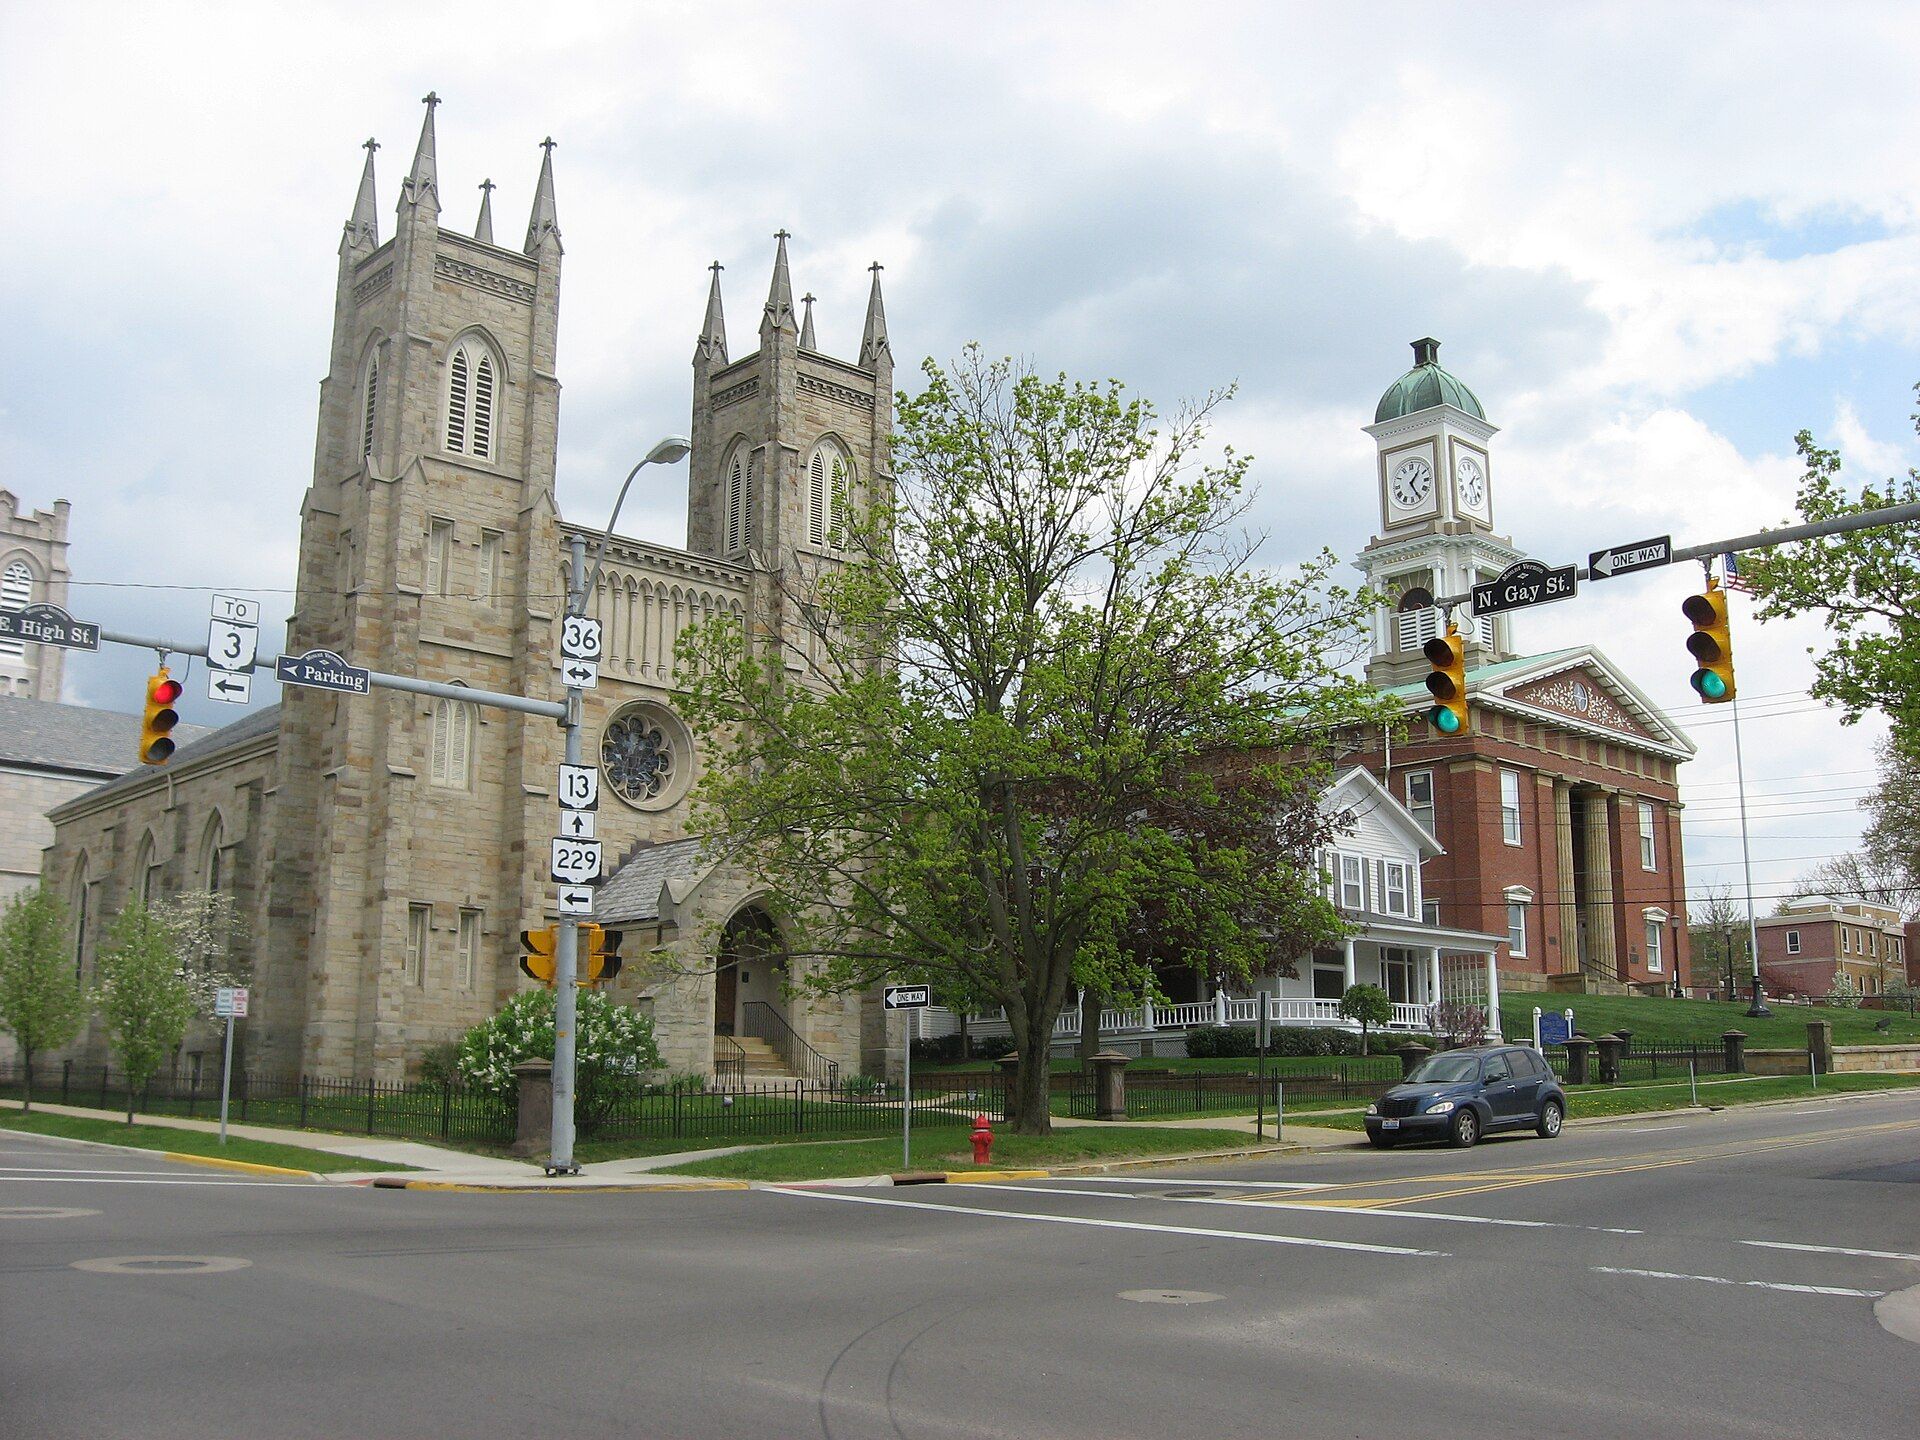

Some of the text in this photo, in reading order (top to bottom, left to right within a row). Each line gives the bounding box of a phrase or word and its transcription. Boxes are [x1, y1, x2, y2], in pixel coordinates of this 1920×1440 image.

[1612, 546, 1662, 567] ONE WAY
[1501, 563, 1544, 581] Mount Vernon
[1478, 576, 1570, 608] N. Gay St.
[224, 601, 247, 617] TO
[0, 616, 94, 644] E. High St.
[566, 624, 597, 650] 36
[223, 632, 242, 659] 3
[304, 665, 365, 690] Parking
[568, 773, 589, 799] 13
[557, 849, 596, 870] 229
[896, 992, 924, 1002] ONE WAY
